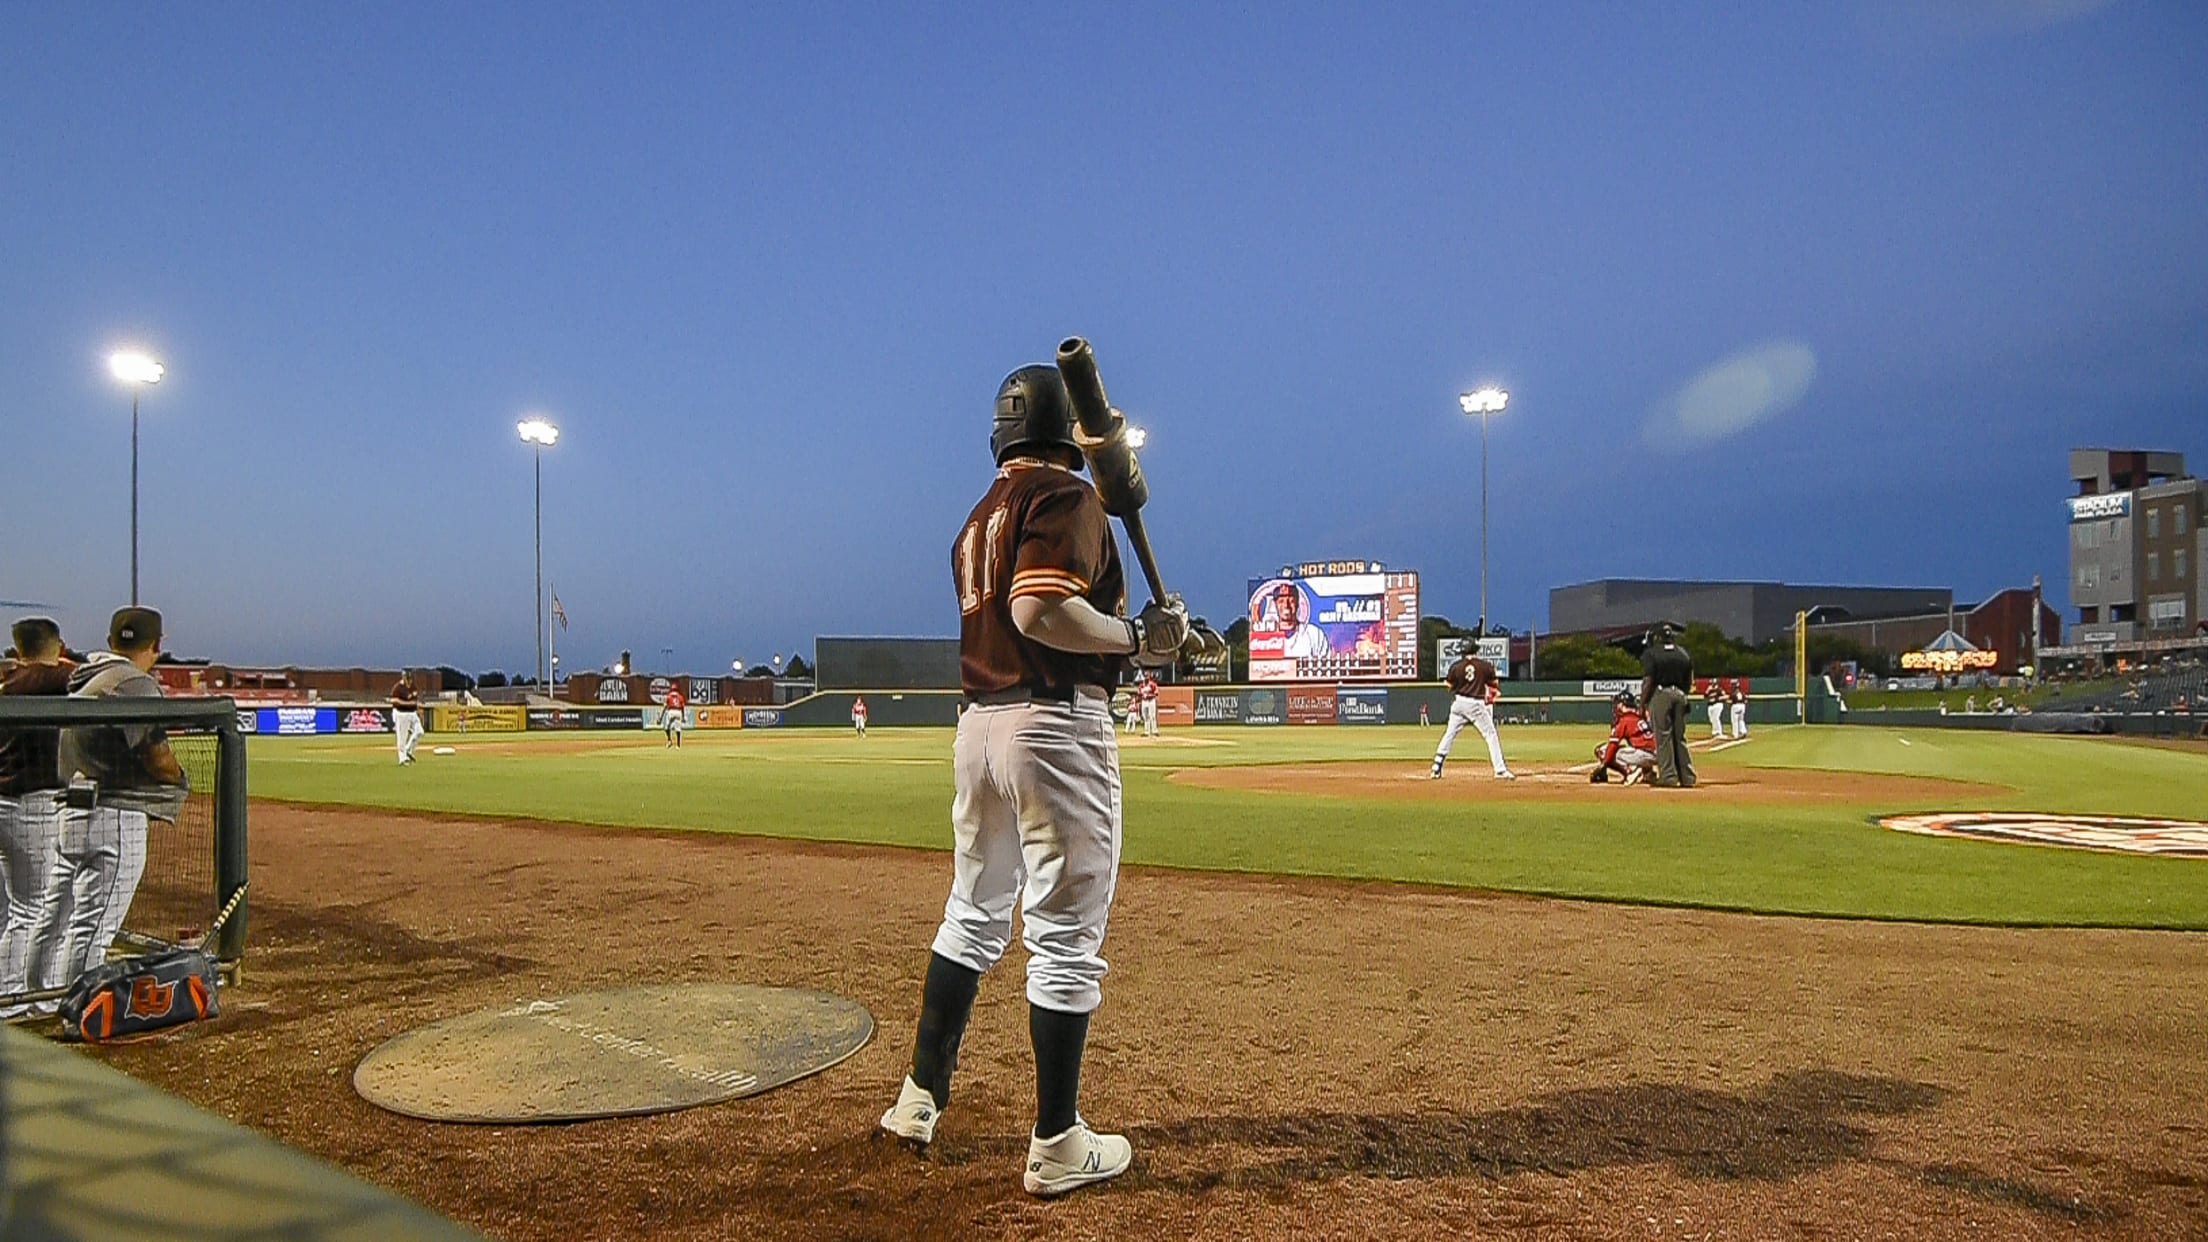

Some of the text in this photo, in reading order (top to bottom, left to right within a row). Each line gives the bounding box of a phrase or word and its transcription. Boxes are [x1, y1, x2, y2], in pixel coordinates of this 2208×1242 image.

[1298, 560, 1366, 576] HOT RODS
[1465, 664, 1475, 682] 3
[600, 690, 628, 702] BARN
